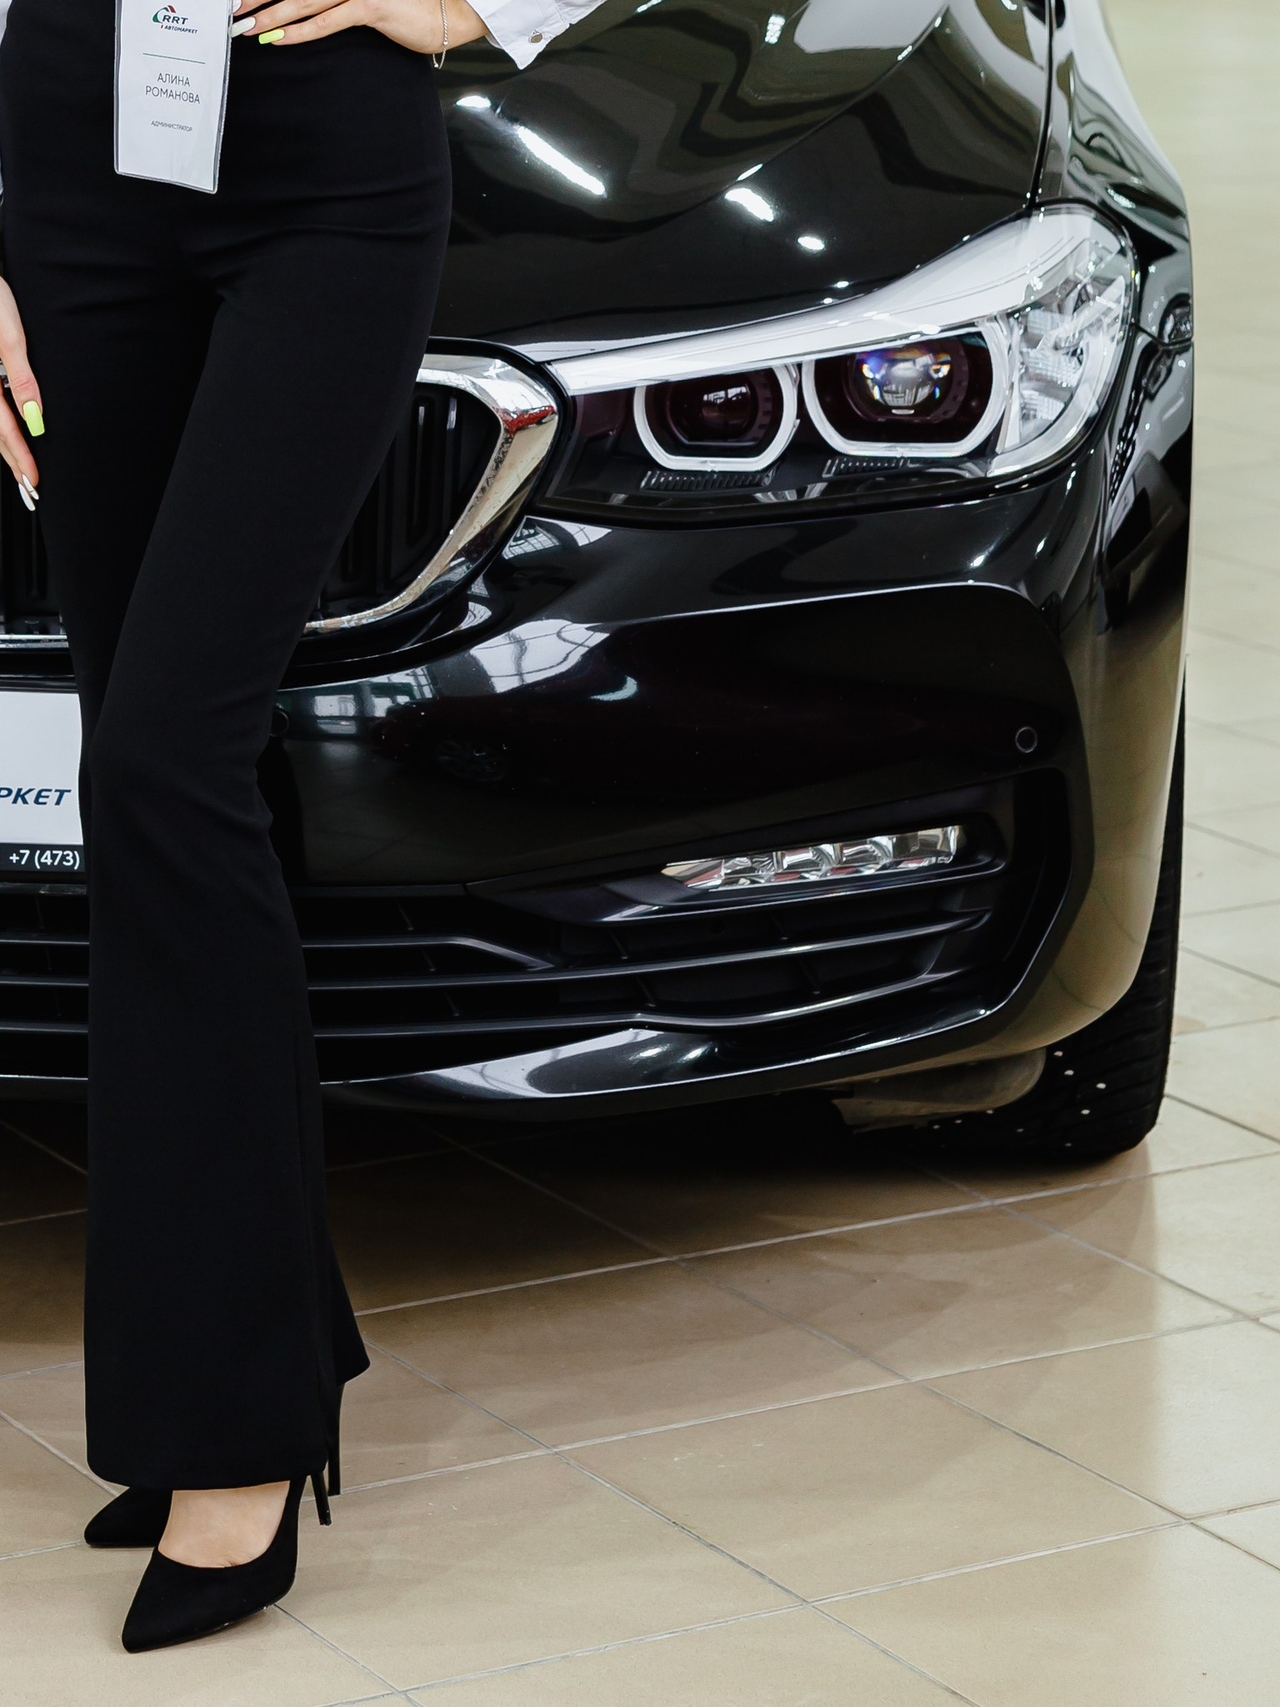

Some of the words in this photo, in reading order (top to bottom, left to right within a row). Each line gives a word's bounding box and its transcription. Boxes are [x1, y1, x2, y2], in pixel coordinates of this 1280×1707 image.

[162, 14, 188, 25] RRT
[164, 25, 198, 35] АВТОМАРКЕТ
[157, 72, 191, 87] АЛИНА
[145, 85, 201, 105] РОМАНОВА
[151, 120, 193, 132] АДМИНИСТРАТОР
[9, 849, 30, 866] +7
[34, 849, 81, 871] (473)
